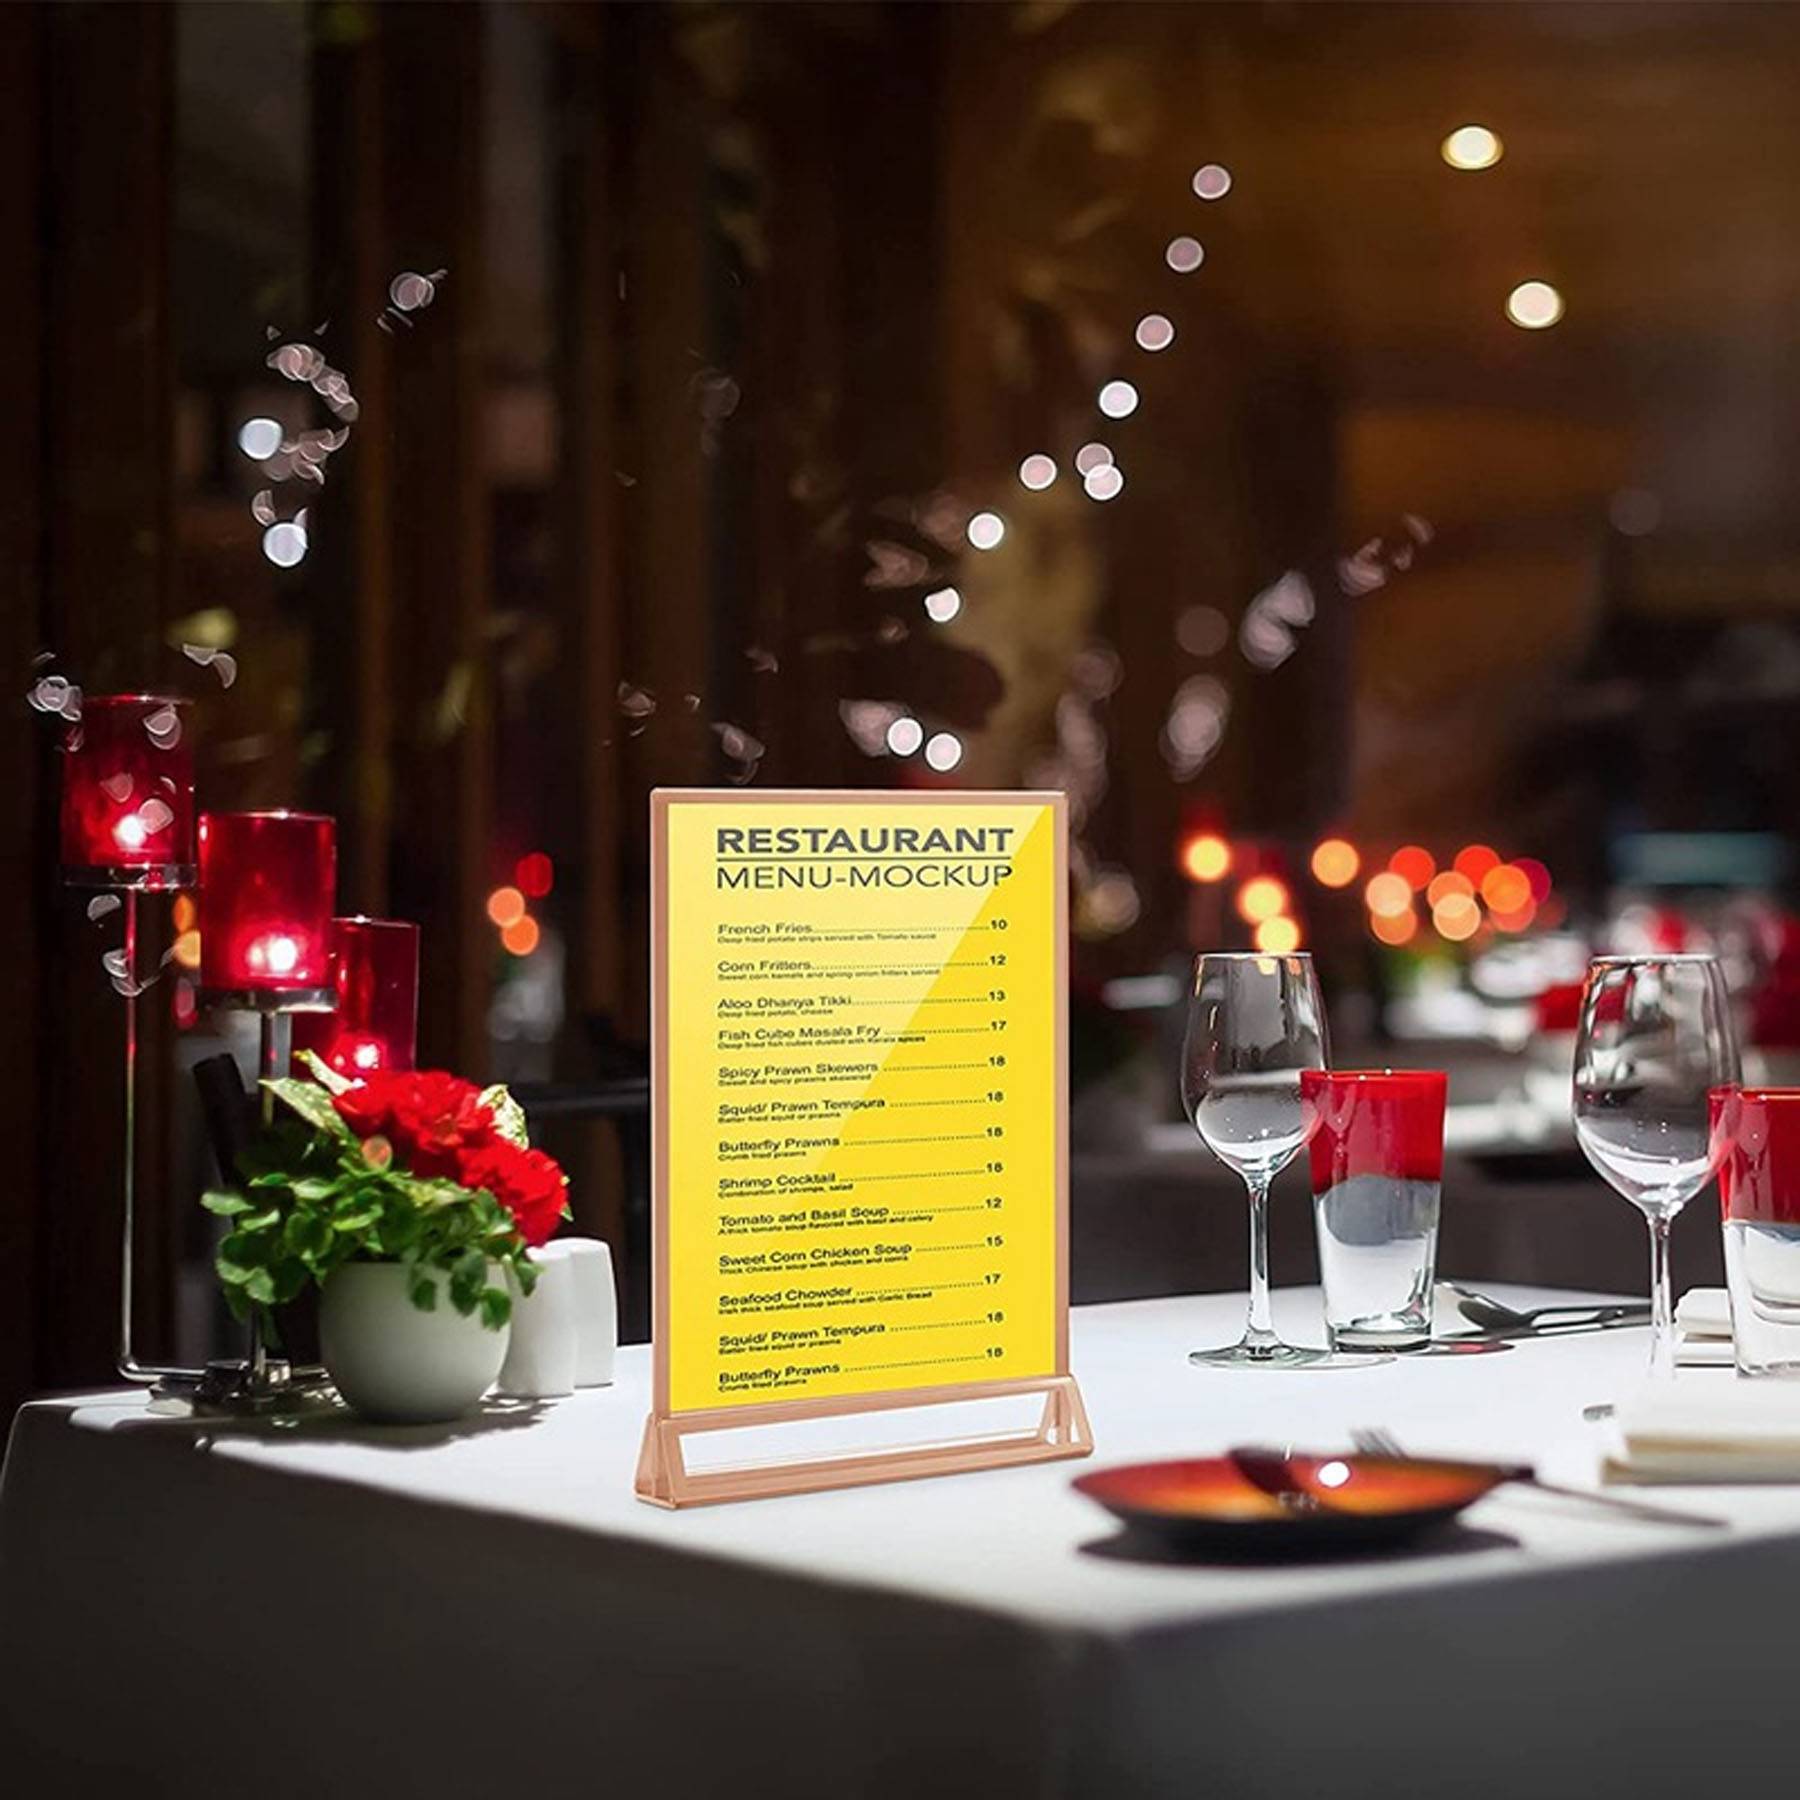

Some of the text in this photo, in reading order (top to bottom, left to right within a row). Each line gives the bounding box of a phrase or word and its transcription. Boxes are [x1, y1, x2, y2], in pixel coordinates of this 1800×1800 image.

[717, 828, 1013, 853] RESTAURANT
[717, 866, 1012, 888] MENU-MOCKUP
[719, 919, 1007, 934] French Fries 10
[718, 955, 1006, 972] Corn Fritters 12
[718, 990, 1005, 1010] Aloo Dhanya Tikki 13
[719, 1021, 1006, 1040] Fish Cube Masala Fry 17
[719, 1056, 1005, 1078] Spicy Prawn Skewers 18
[771, 1102, 818, 1112] Prawn
[822, 1099, 885, 1111] Tempura
[987, 1091, 1003, 1102] 18
[719, 1127, 1003, 1152] Butterfly Prawns 18
[719, 1162, 1003, 1190] Shrimp Cocktail 18
[720, 1198, 1002, 1226] Tomato and Basil Soup 12
[719, 1236, 1003, 1267] Sweet Corn Chicken Soup 15
[719, 1273, 1001, 1307] Seafood Chowder 17
[771, 1330, 819, 1341] Prawn
[822, 1325, 885, 1337] Tempura
[987, 1311, 1003, 1322] 18
[719, 1347, 1003, 1384] Butterfly Prawns 18
